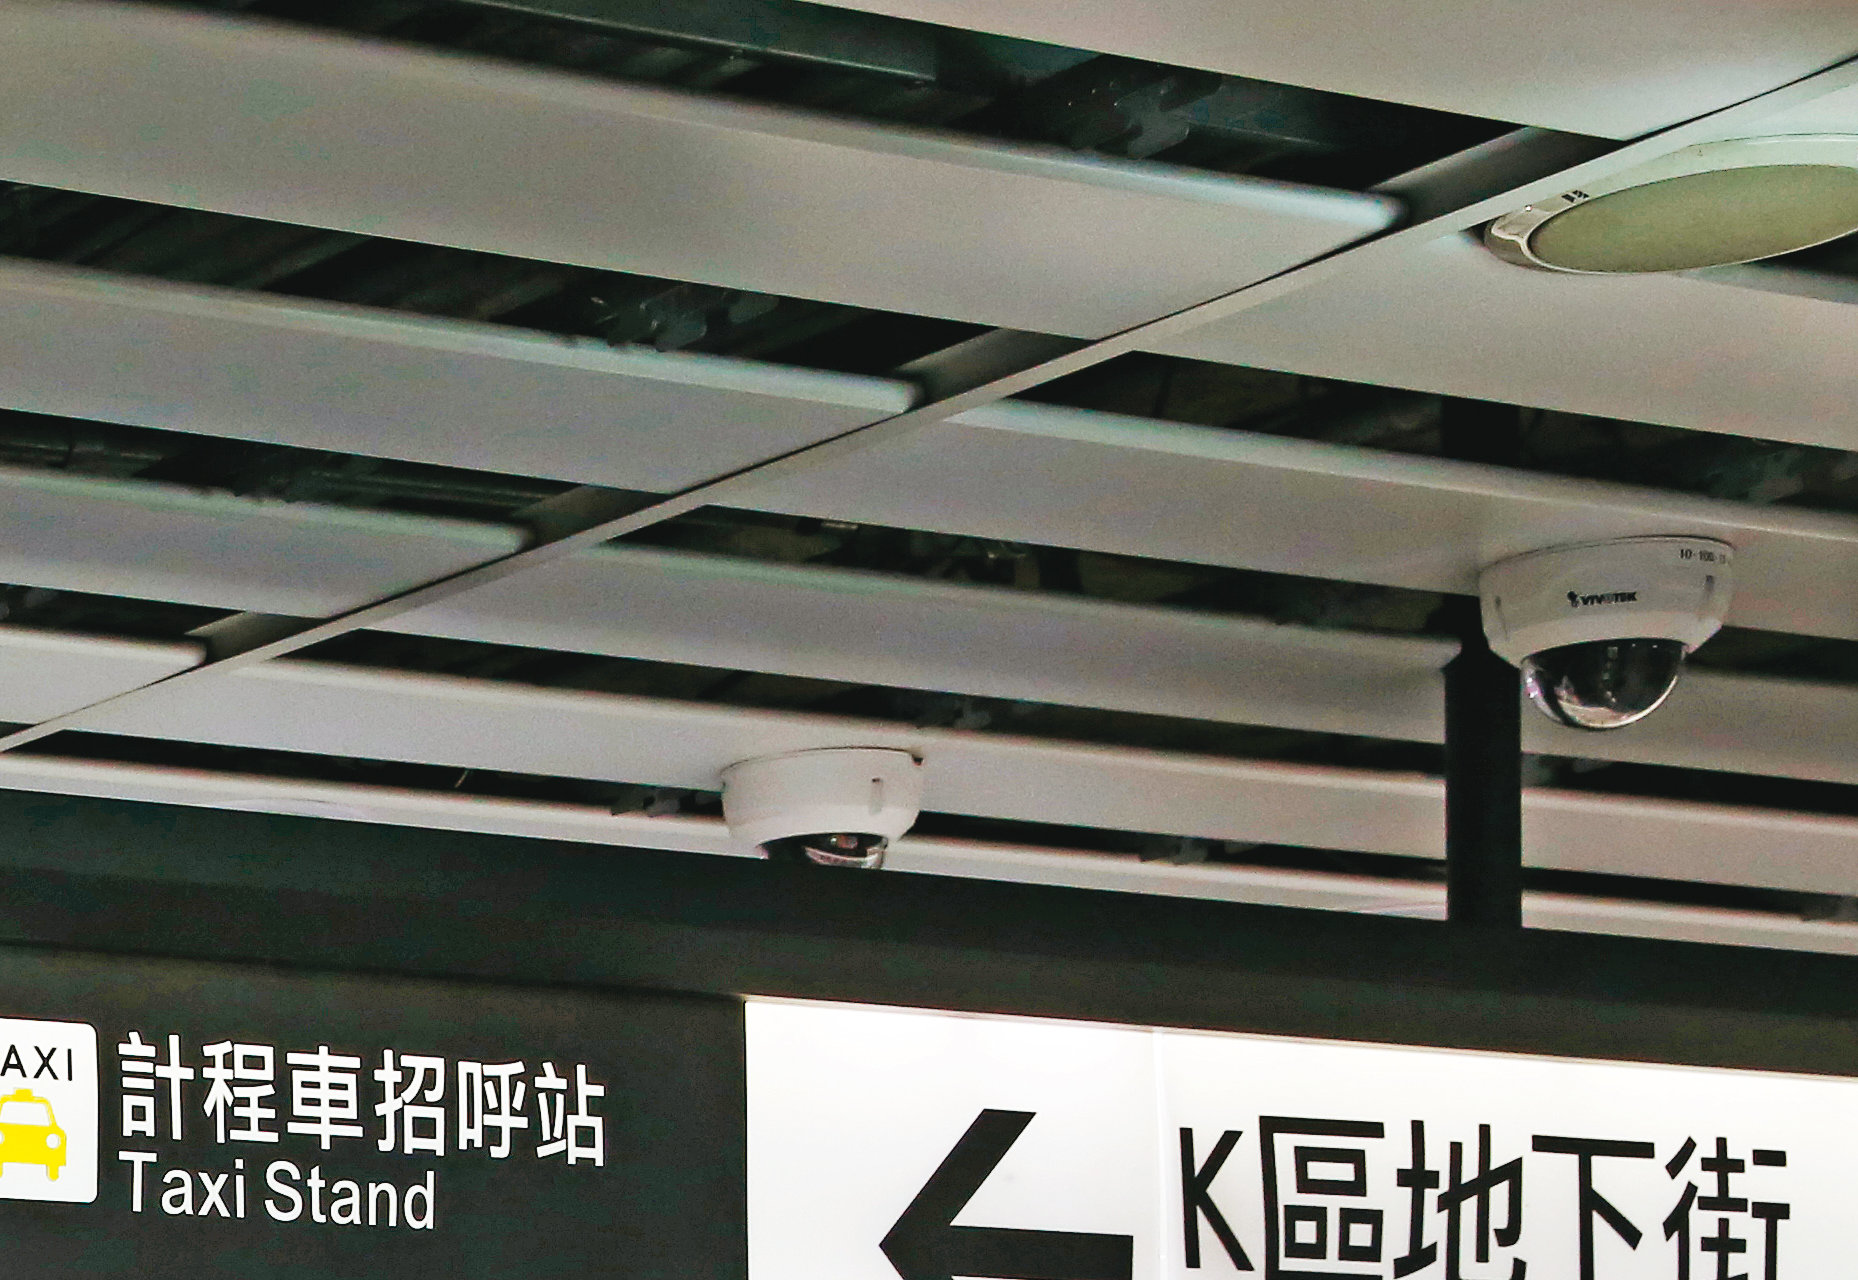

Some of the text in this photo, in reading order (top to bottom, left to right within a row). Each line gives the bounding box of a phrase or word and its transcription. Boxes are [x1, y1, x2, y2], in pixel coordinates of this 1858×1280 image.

[1579, 591, 1637, 605] VIVOTEK
[118, 1031, 605, 1167] 計程車招呼站
[118, 1150, 435, 1230] Taxi Stand
